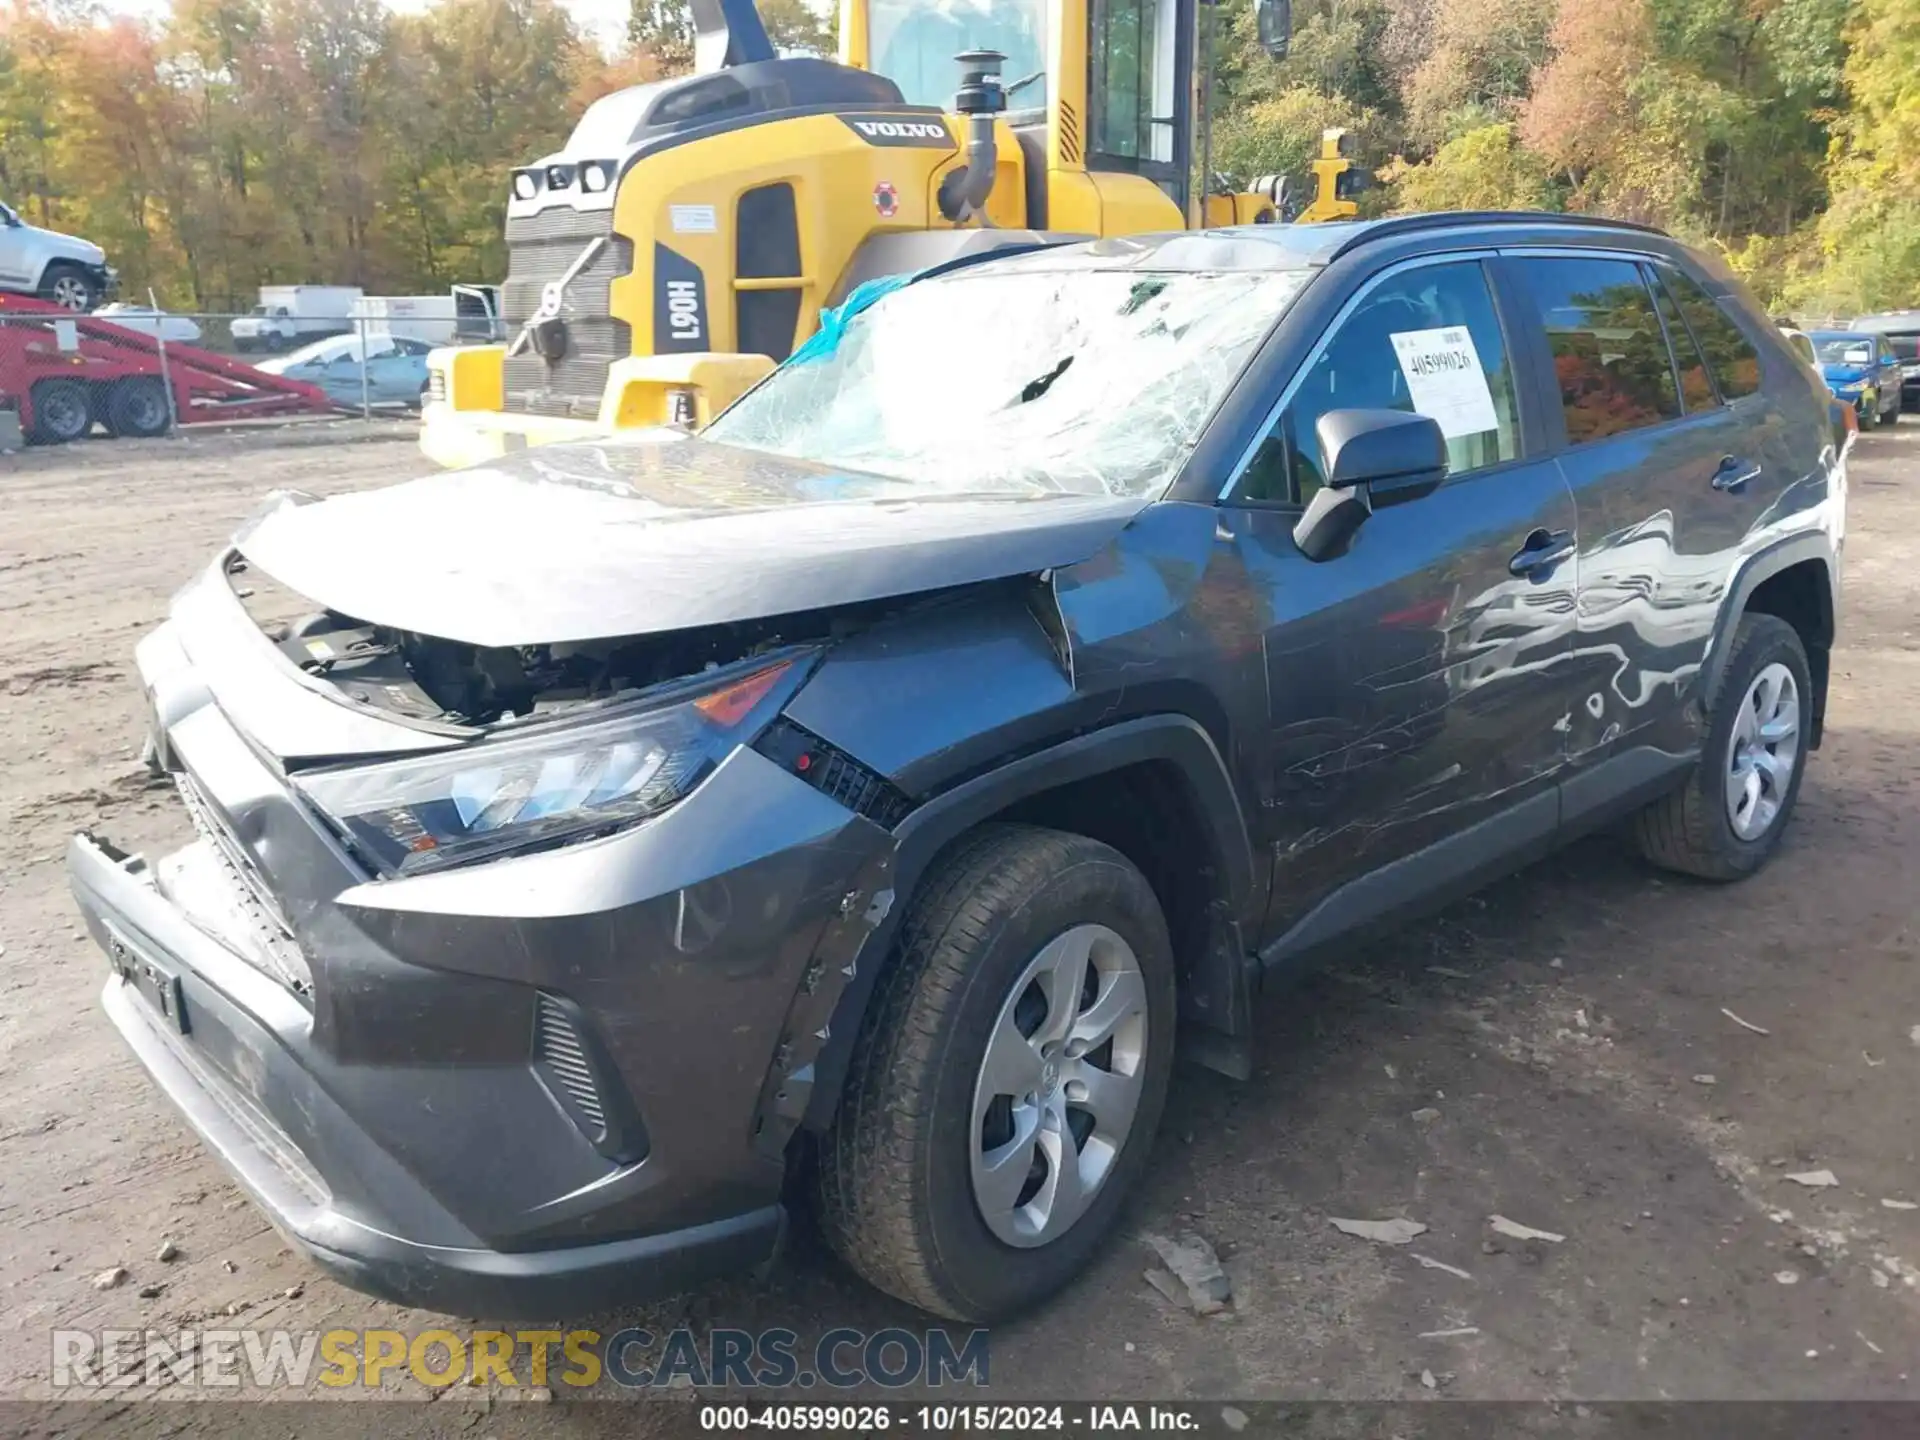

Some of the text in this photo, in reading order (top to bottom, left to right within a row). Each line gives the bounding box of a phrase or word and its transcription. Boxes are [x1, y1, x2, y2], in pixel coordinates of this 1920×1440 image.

[854, 122, 945, 138] VOLVO
[667, 281, 700, 339] L90H
[1410, 350, 1471, 376] 40599026
